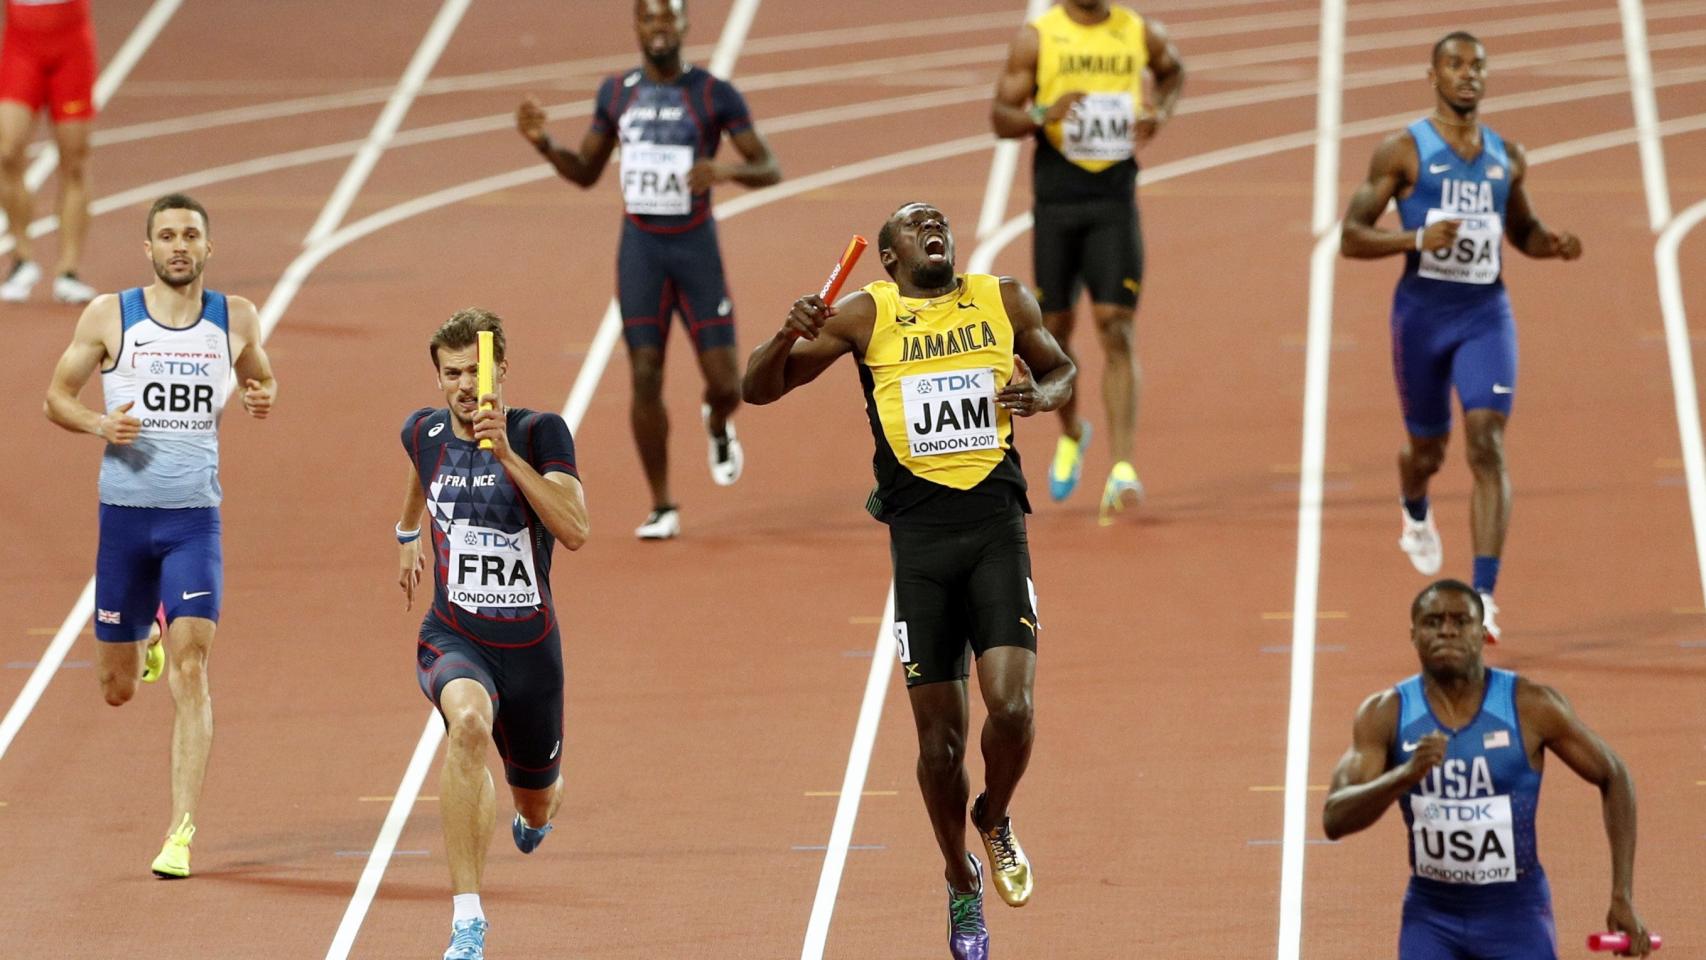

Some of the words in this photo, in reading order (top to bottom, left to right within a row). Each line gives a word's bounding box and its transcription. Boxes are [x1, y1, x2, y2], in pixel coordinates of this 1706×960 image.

[1069, 118, 1129, 143] JAM
[624, 170, 682, 195] FRA
[1441, 178, 1494, 213] USA
[900, 321, 997, 362] JAMAICA
[166, 361, 211, 377] TDK
[932, 374, 981, 392] TDK
[142, 382, 214, 413] GBR
[142, 418, 189, 430] ONDON
[191, 419, 214, 430] 2017
[914, 397, 990, 435] JAM
[914, 438, 969, 453] LONDON
[971, 435, 995, 447] 2017
[444, 474, 496, 488] FRANCE
[477, 532, 522, 551] TDK
[457, 553, 533, 587] FRA
[453, 591, 506, 603] LONDON
[508, 592, 535, 604] 2017
[1420, 756, 1495, 799] USA
[1440, 803, 1494, 821] TDK
[1421, 827, 1507, 863] USA
[1419, 865, 1476, 881] LONDON
[1478, 867, 1510, 881] 2017
